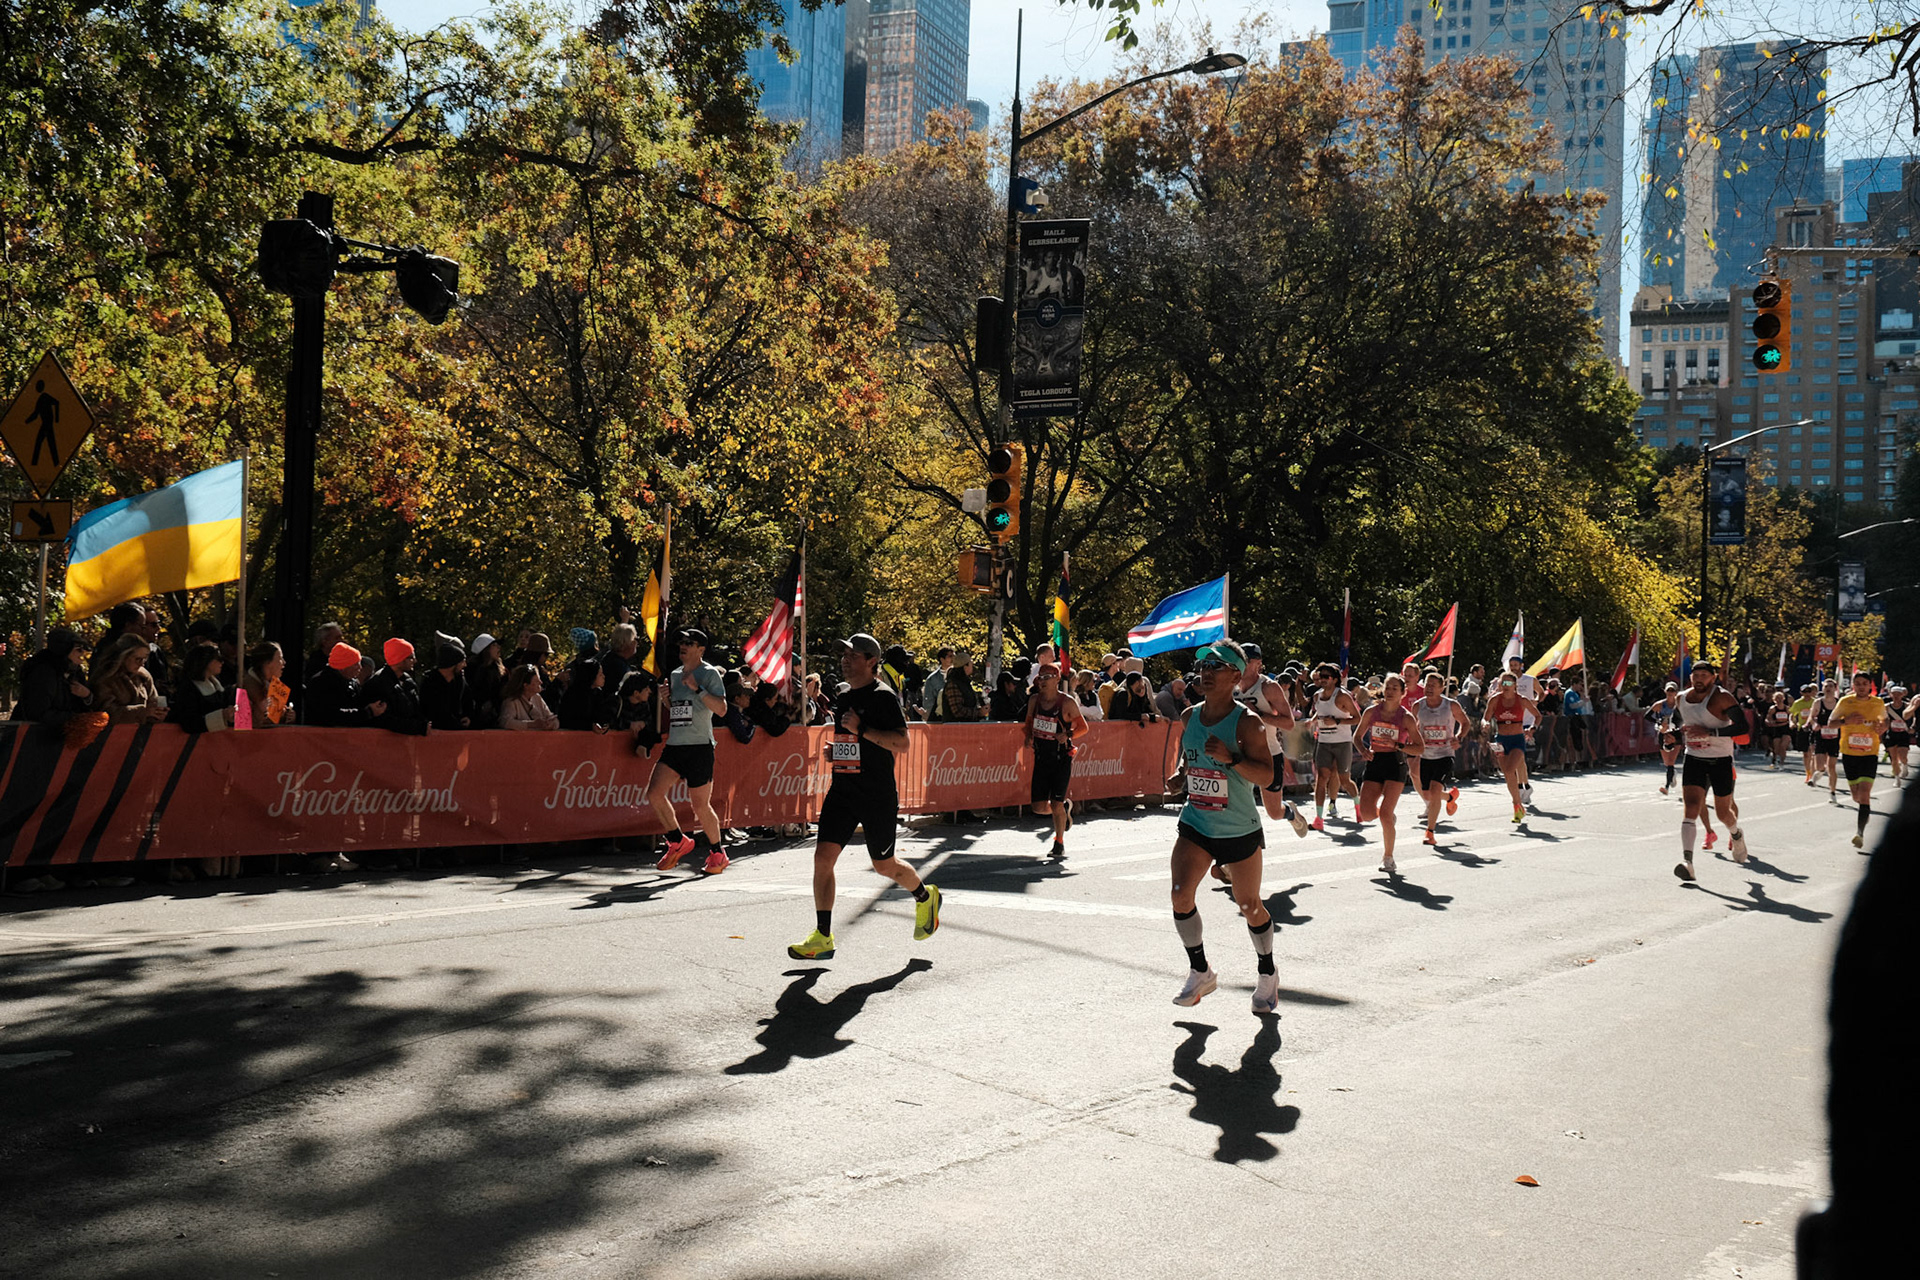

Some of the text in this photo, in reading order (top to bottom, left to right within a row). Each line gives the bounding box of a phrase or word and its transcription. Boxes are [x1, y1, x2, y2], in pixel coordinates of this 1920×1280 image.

[1020, 387, 1073, 397] TEGLA LOROUPE
[1818, 646, 1833, 655] 26
[759, 753, 833, 797] Knocka
[923, 747, 1019, 787] Knockaround
[267, 761, 459, 818] Knockaround
[1192, 777, 1220, 793] 5270
